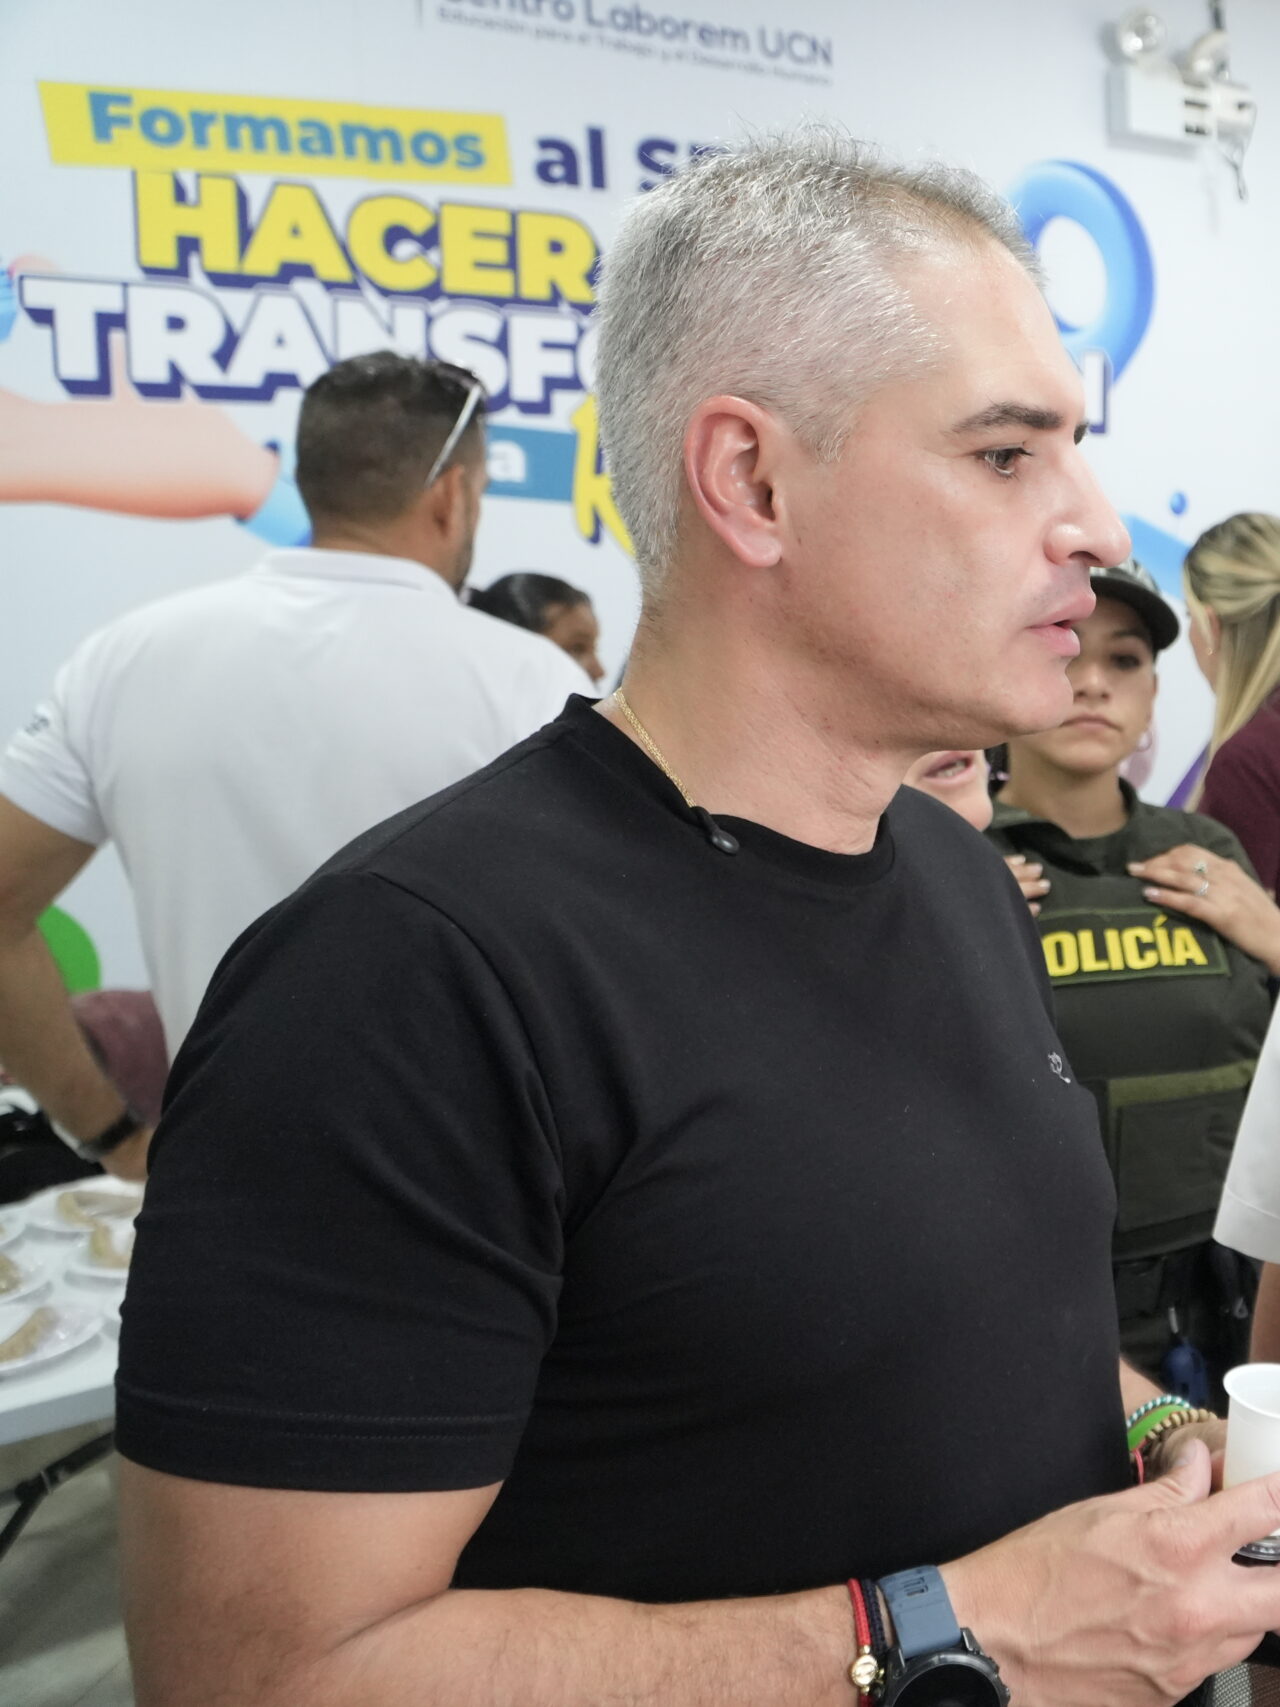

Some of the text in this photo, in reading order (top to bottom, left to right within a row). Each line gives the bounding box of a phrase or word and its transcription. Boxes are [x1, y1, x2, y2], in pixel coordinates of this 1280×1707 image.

[585, 0, 750, 53] Laborem
[757, 25, 833, 67] UCN
[87, 91, 486, 170] Formamos
[535, 126, 606, 189] al
[133, 168, 600, 306] HACER
[20, 274, 602, 406] TRANSF
[1041, 914, 1208, 977] OLICÍA
